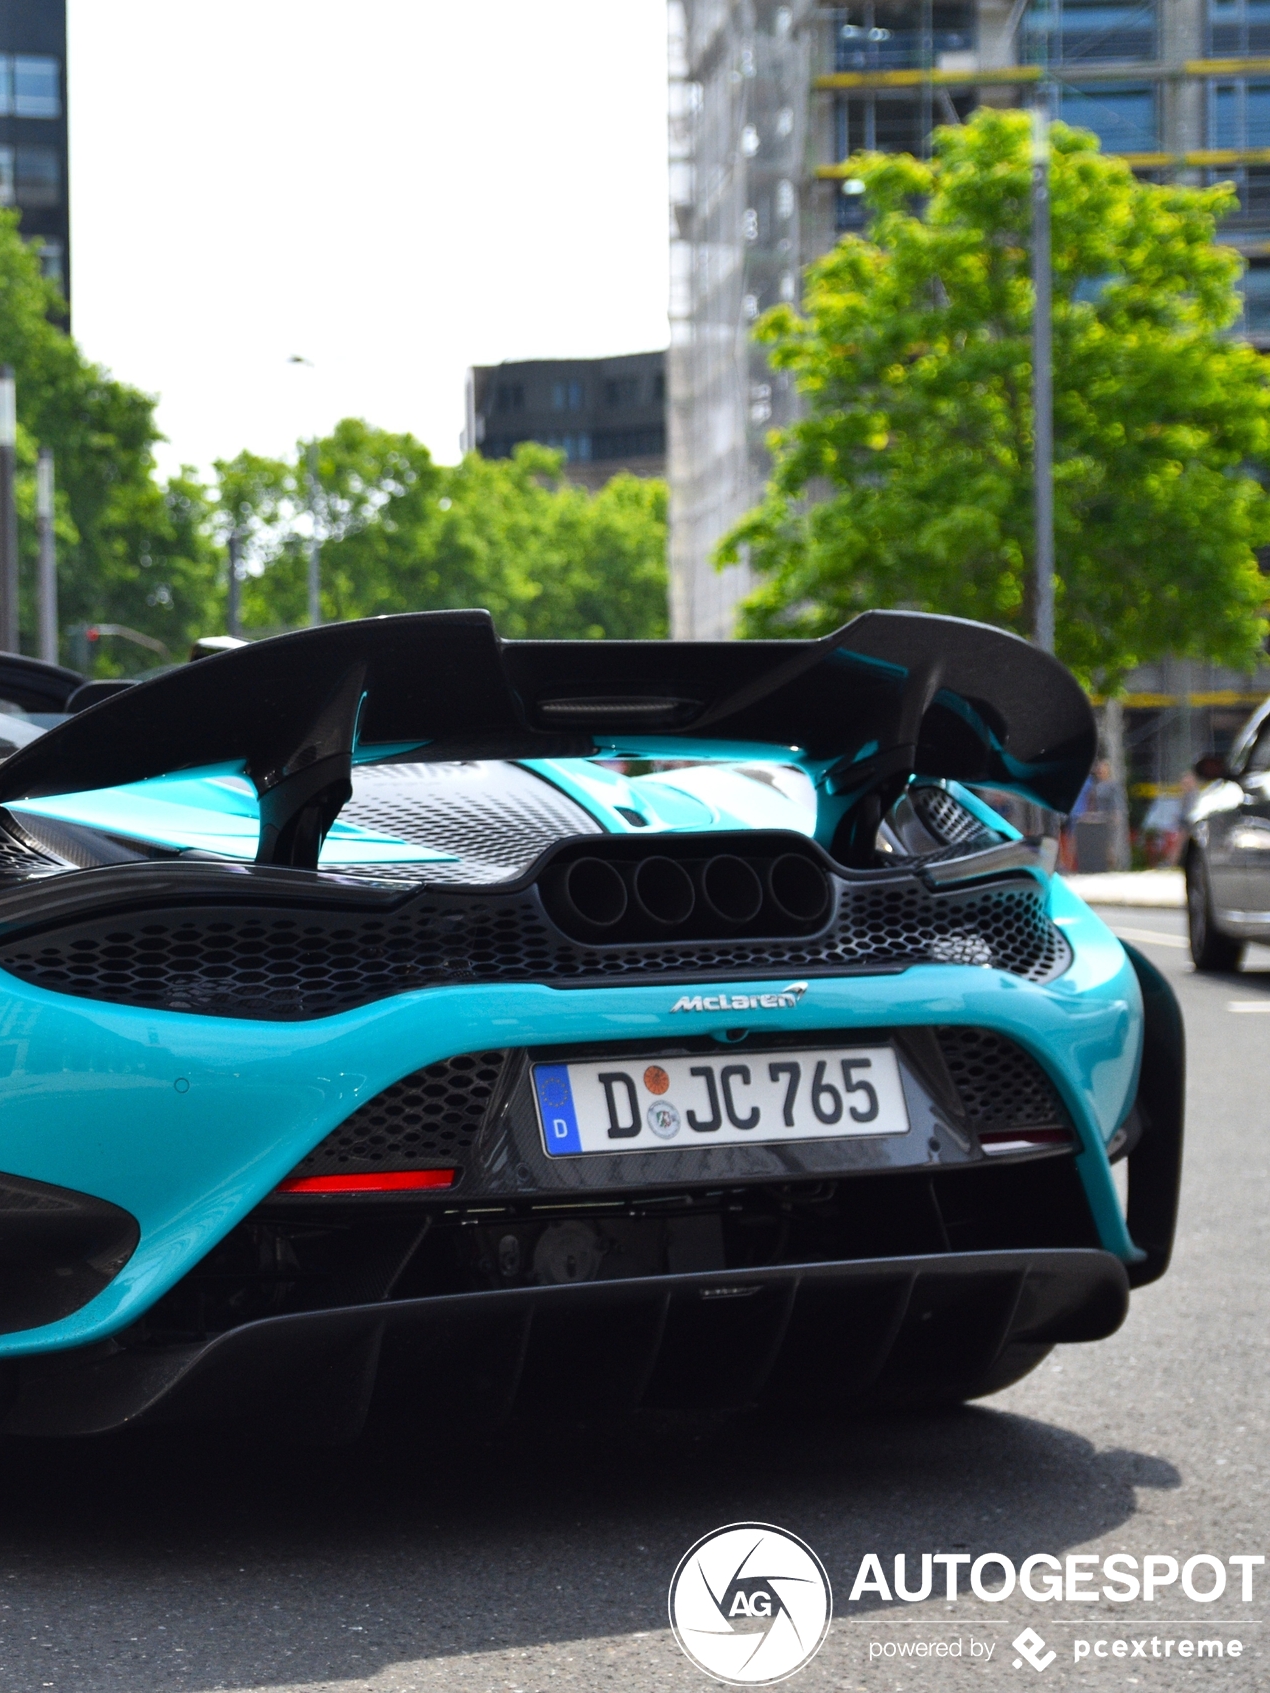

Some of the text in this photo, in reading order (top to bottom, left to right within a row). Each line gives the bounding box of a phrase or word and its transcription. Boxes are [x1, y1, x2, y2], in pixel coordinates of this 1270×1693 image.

[669, 993, 796, 1014] McLaren
[598, 1071, 643, 1139] D
[686, 1064, 761, 1133] JC
[768, 1057, 880, 1128] 765
[553, 1119, 568, 1139] D
